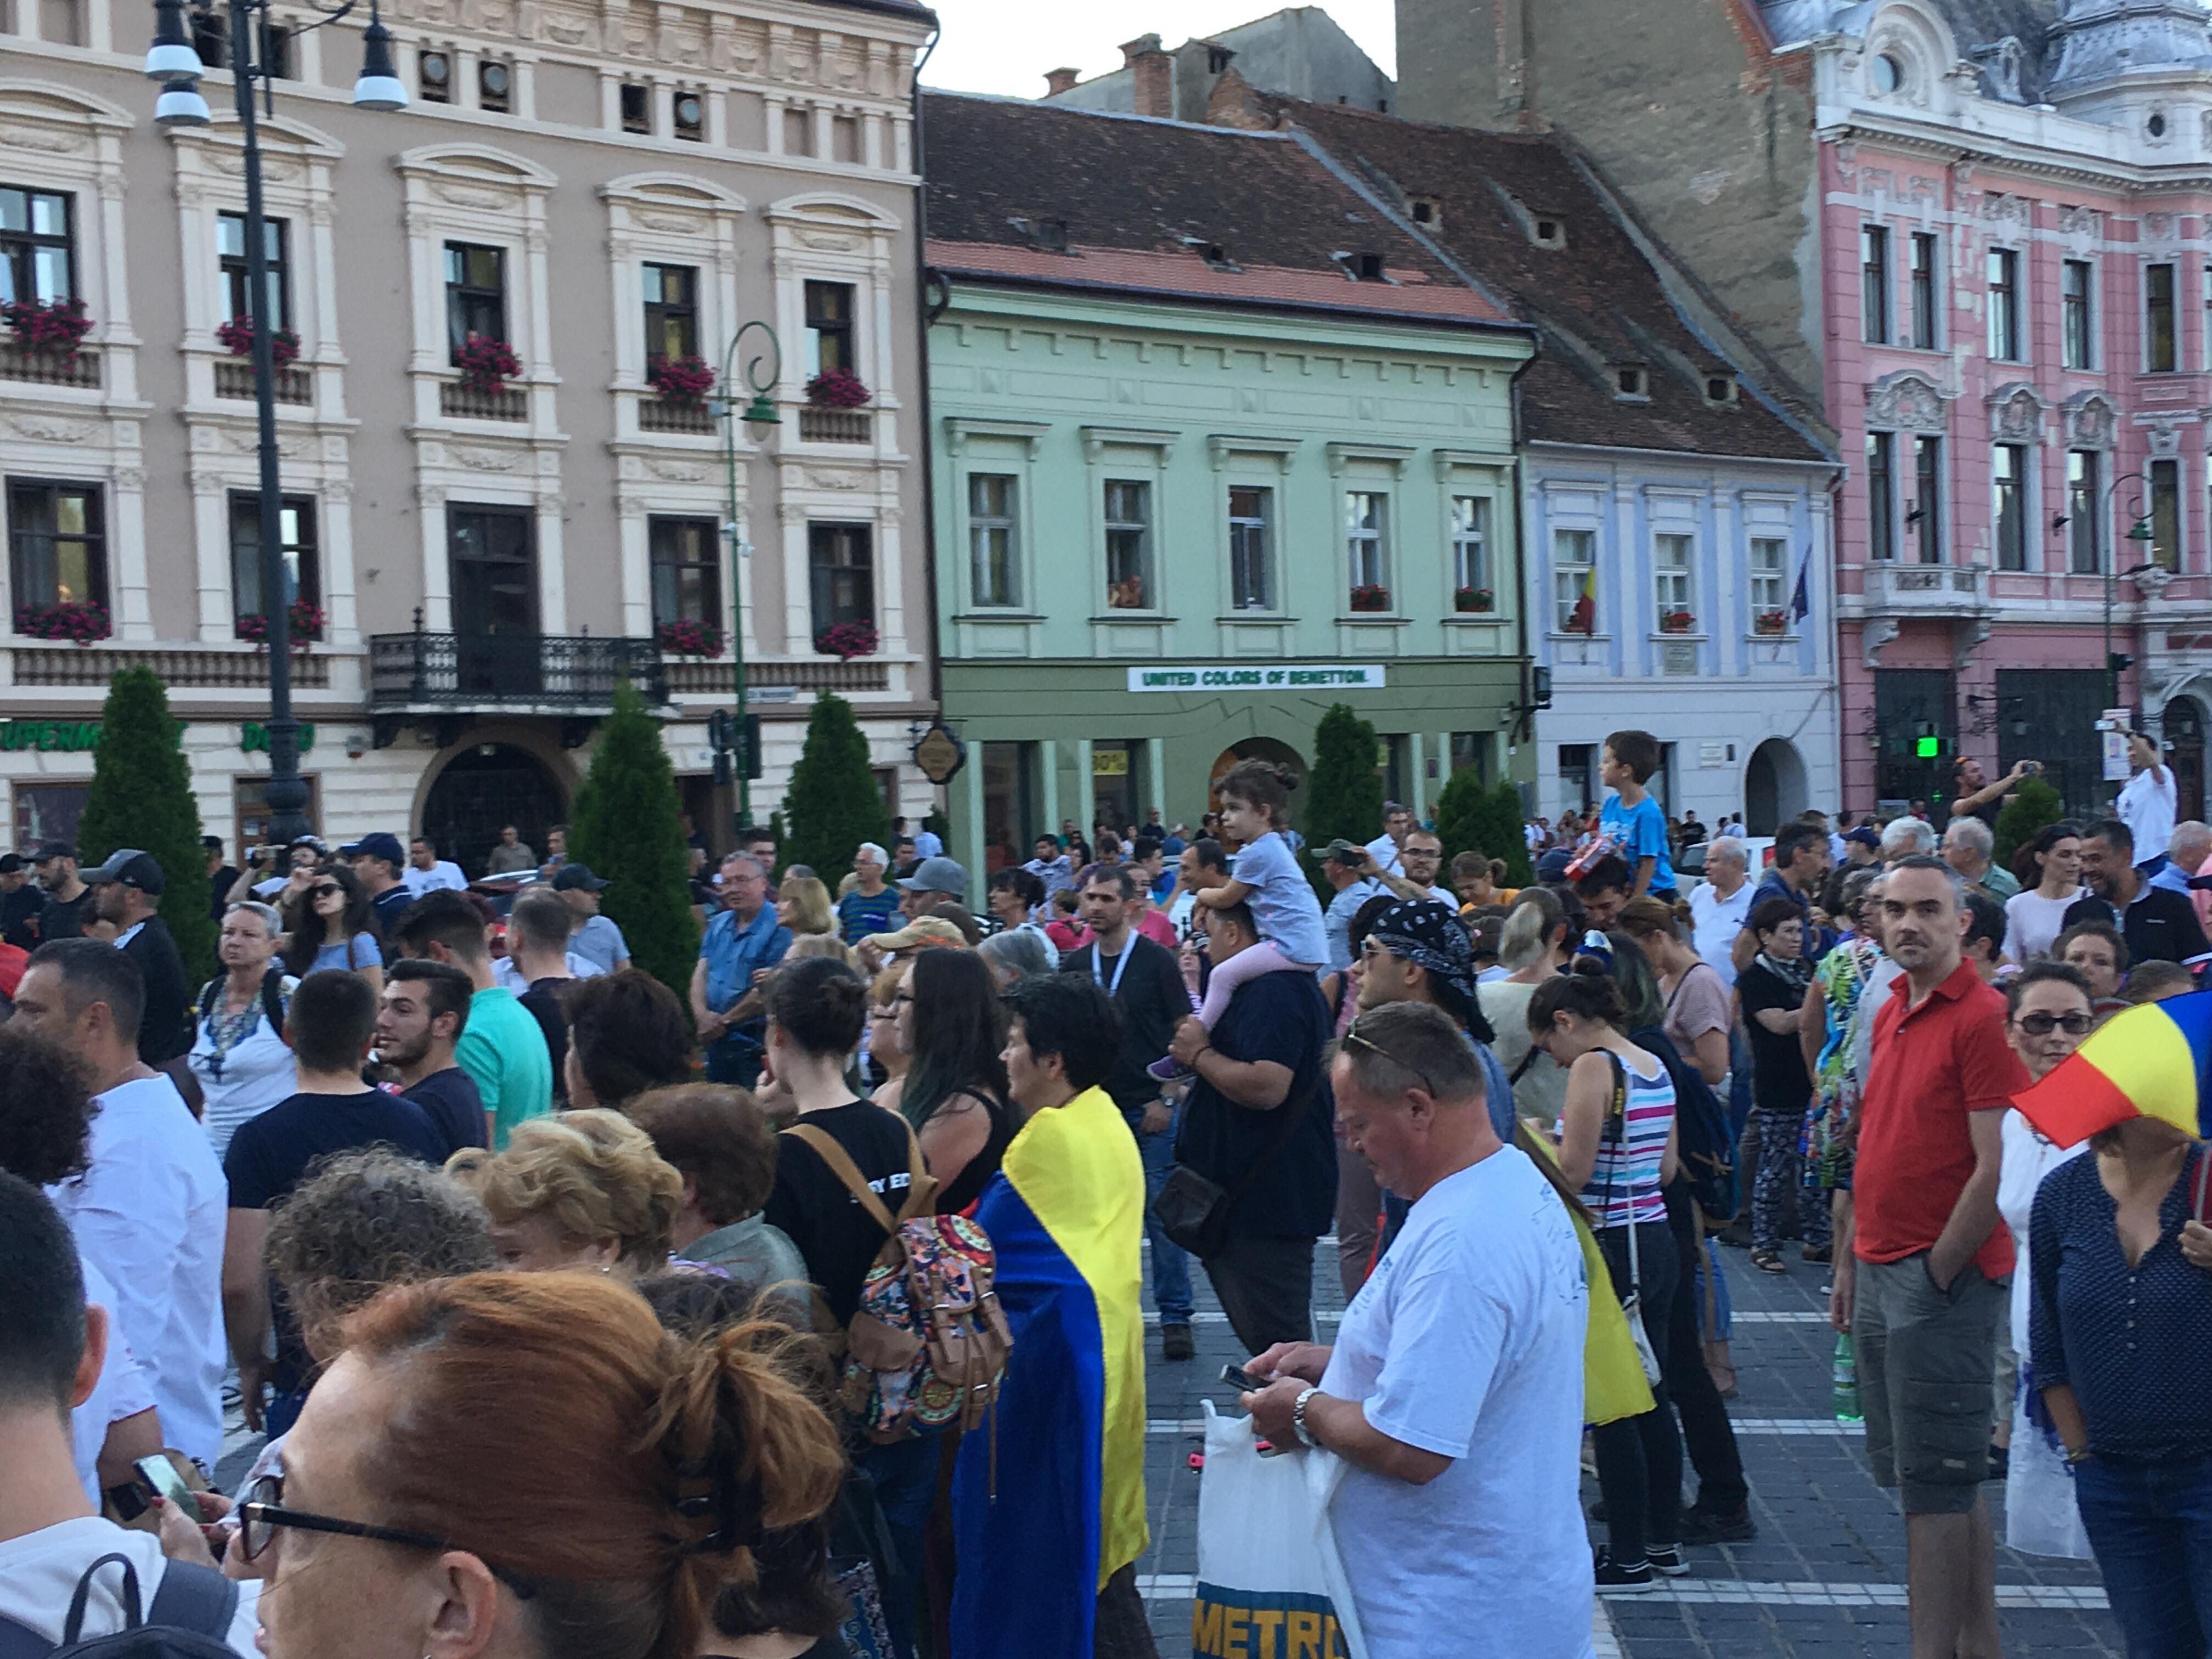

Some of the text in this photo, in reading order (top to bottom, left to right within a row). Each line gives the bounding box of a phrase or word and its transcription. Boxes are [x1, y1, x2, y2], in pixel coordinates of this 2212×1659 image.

[1142, 672, 1196, 686] UNITED
[1202, 671, 1262, 685] COLORS
[1266, 670, 1285, 684] OF
